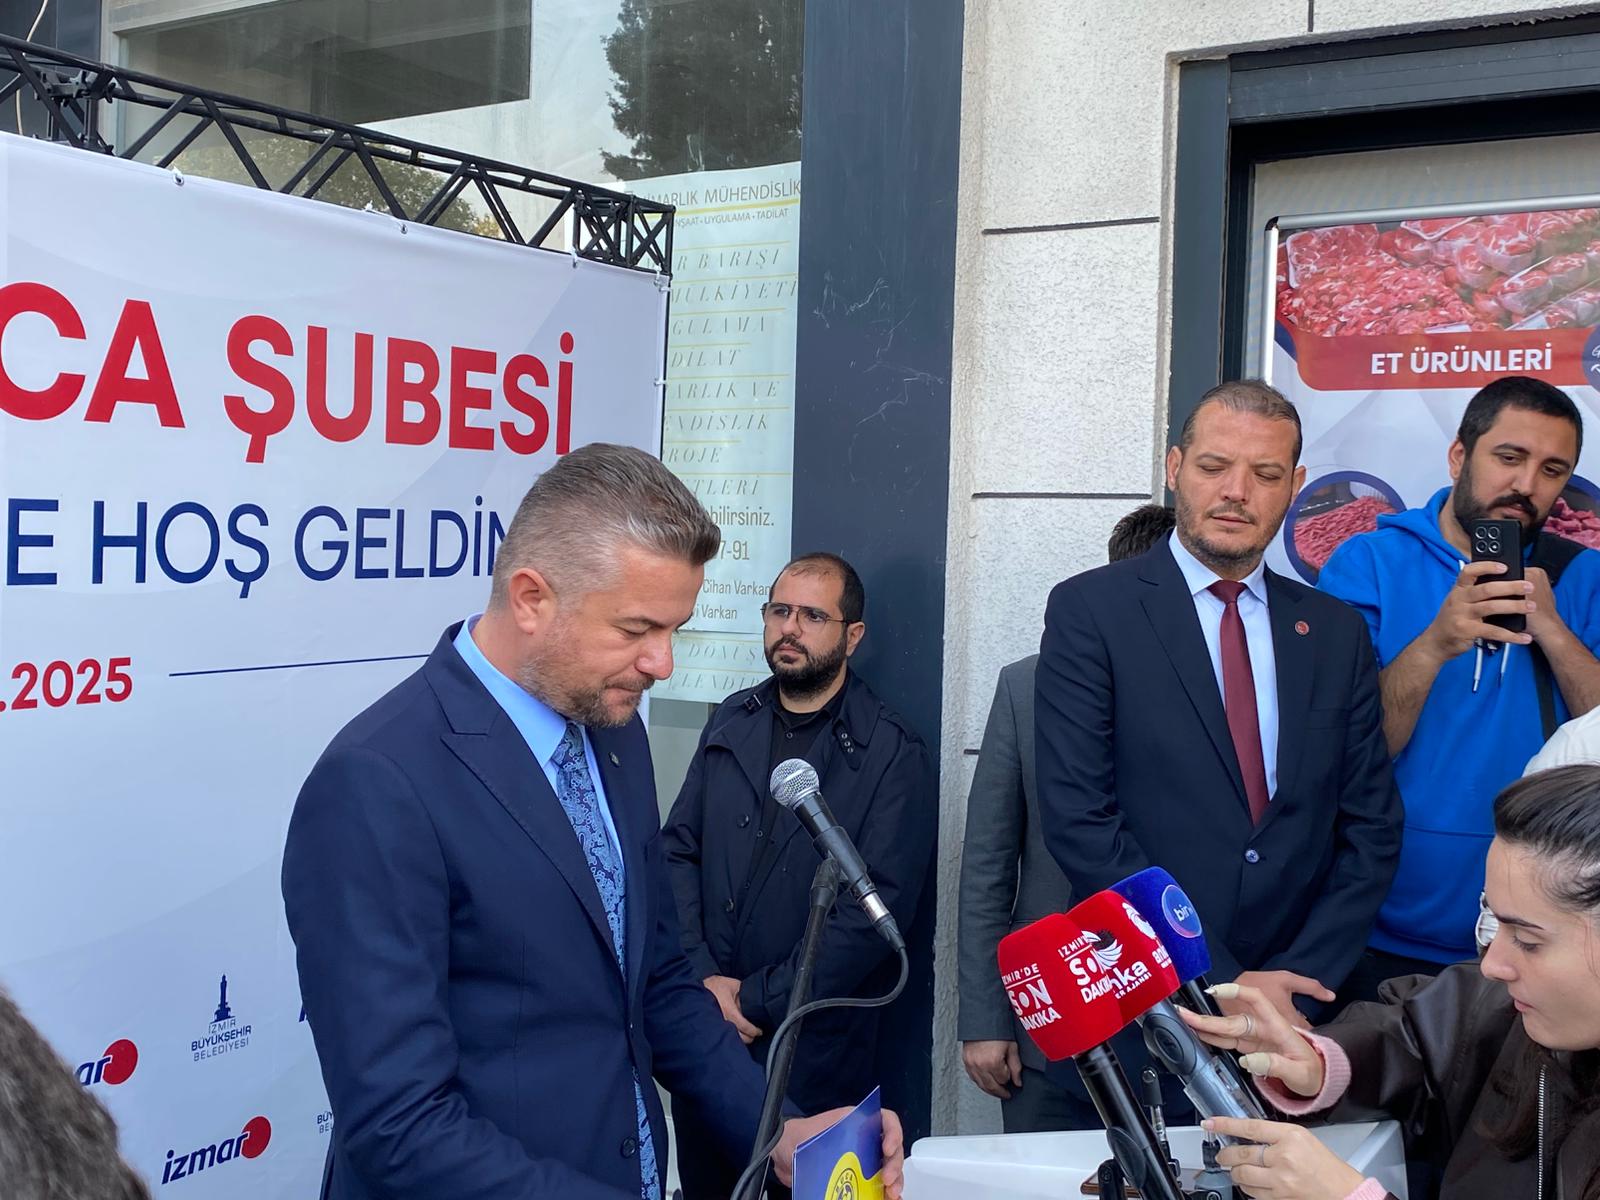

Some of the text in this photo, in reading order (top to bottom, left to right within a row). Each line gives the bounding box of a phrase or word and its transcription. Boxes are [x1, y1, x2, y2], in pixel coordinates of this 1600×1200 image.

[704, 180, 801, 204] MÜHENDİSLİK
[704, 213, 751, 226] UYGULAMA
[757, 207, 789, 220] TADİLAT
[1371, 342, 1552, 375] ET ÜRÜNLERİ
[0, 281, 575, 464] CA ŞUBESİ
[664, 447, 723, 463] ROJE
[683, 475, 760, 496] TLERİ
[92, 500, 270, 599] HOŞ
[703, 579, 771, 596] Cihan Varkan
[701, 604, 738, 620] Varkan
[1008, 978, 1053, 1016] SON
[162, 1132, 249, 1185] izmar
